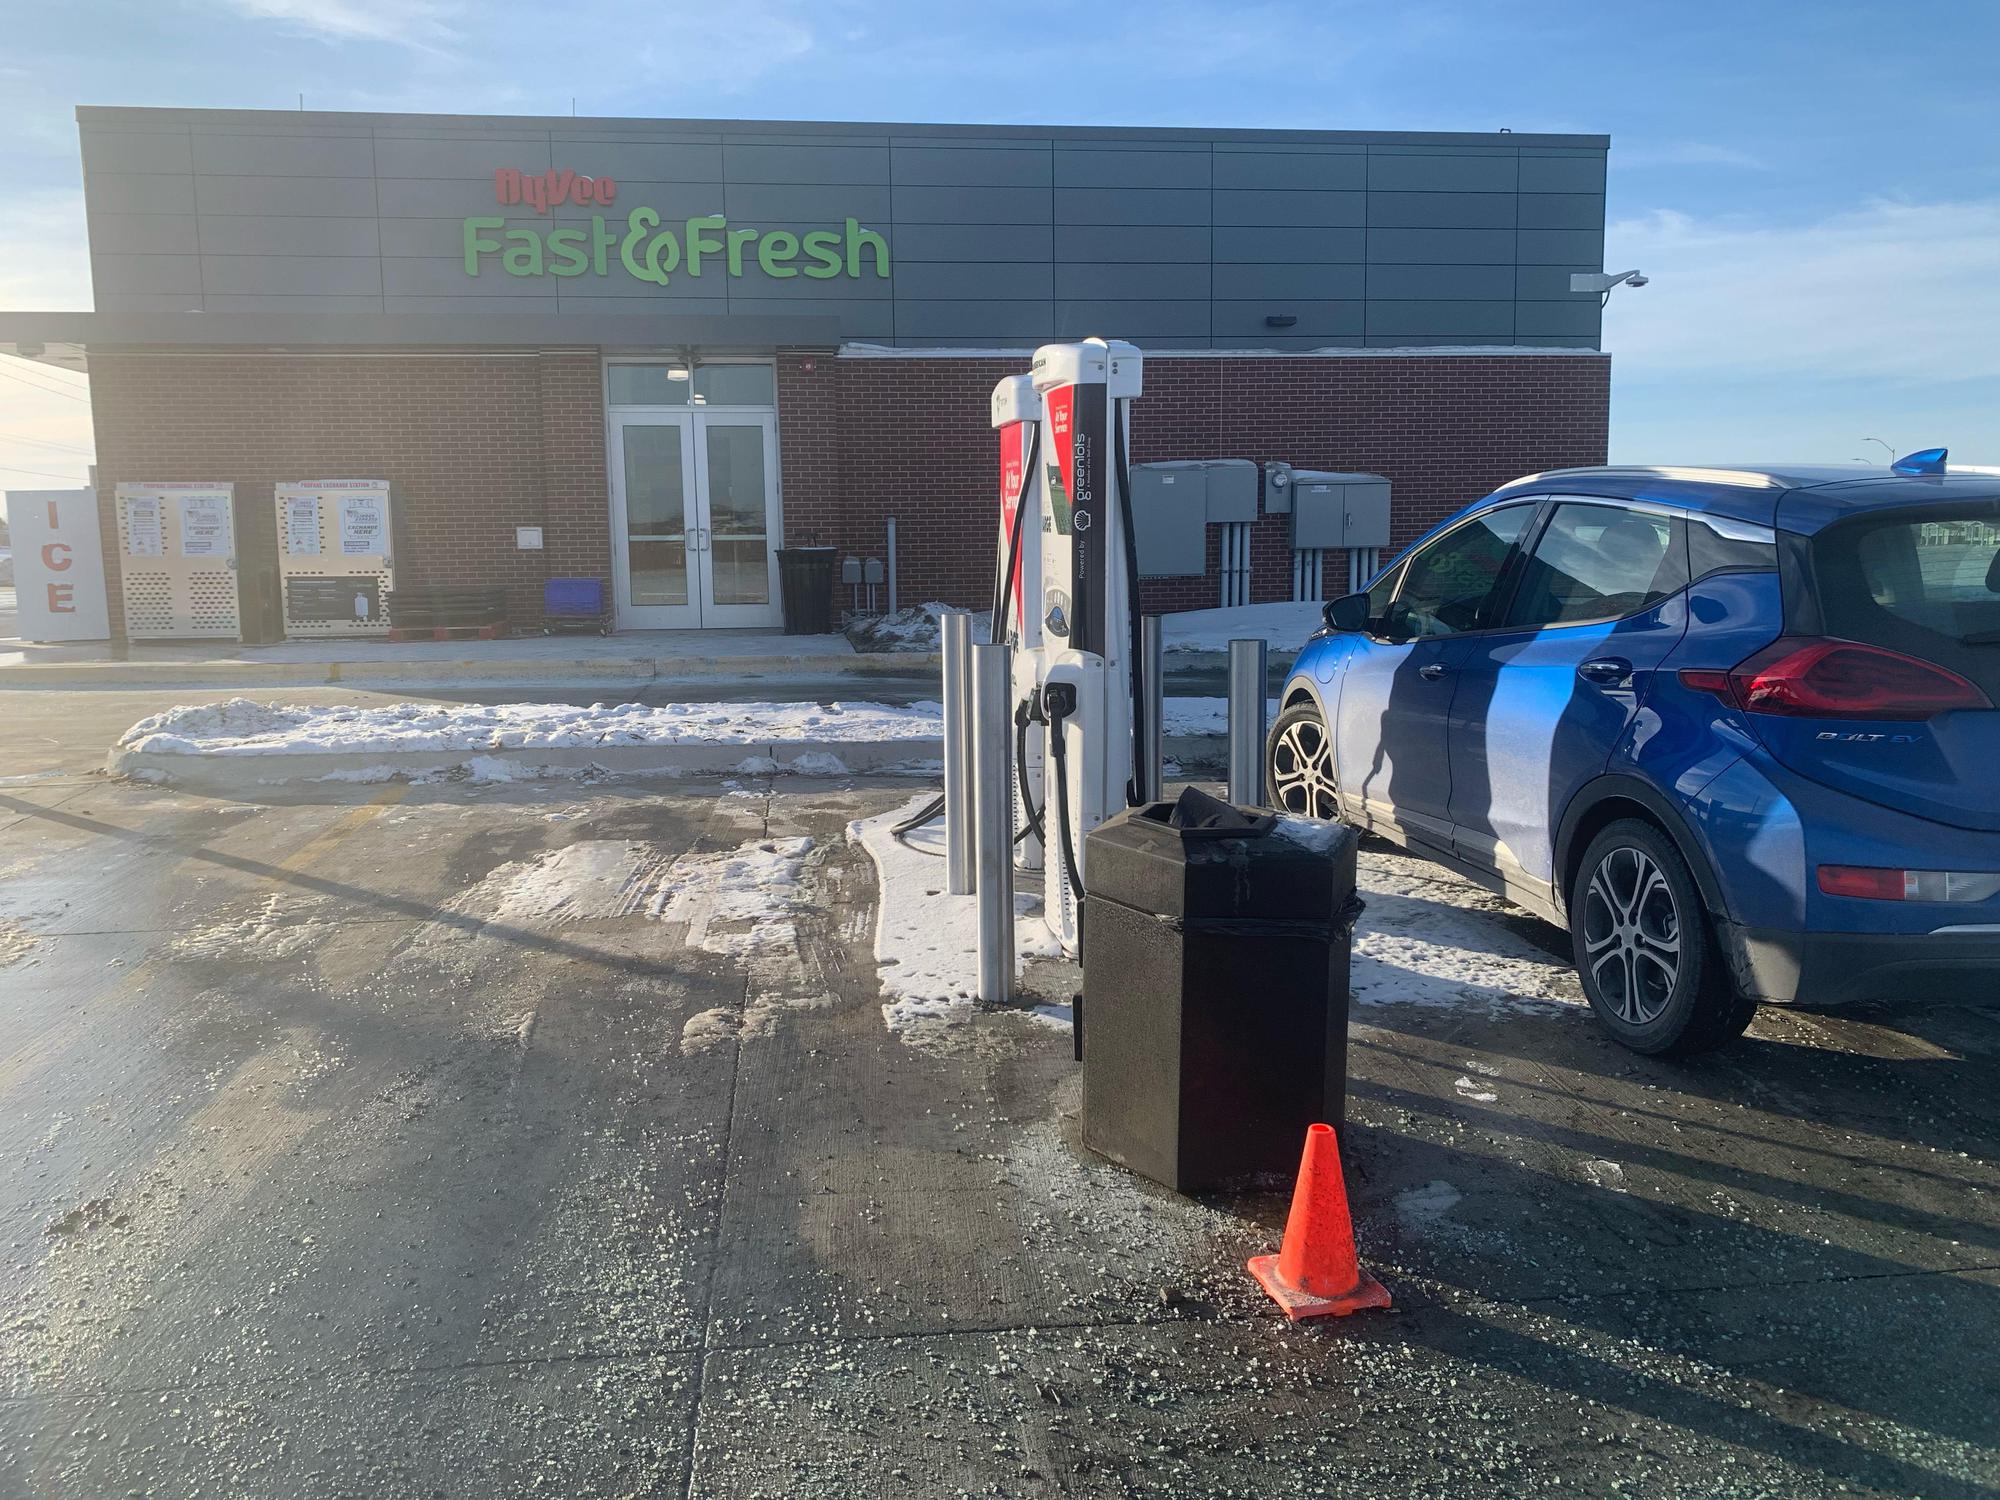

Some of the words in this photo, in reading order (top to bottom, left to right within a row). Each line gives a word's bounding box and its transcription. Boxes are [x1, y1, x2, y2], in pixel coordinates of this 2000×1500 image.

[1075, 433, 1091, 501] greenlots
[1078, 539, 1086, 549] by
[1815, 732, 1886, 742] BOLT
[1890, 734, 1923, 743] EV
